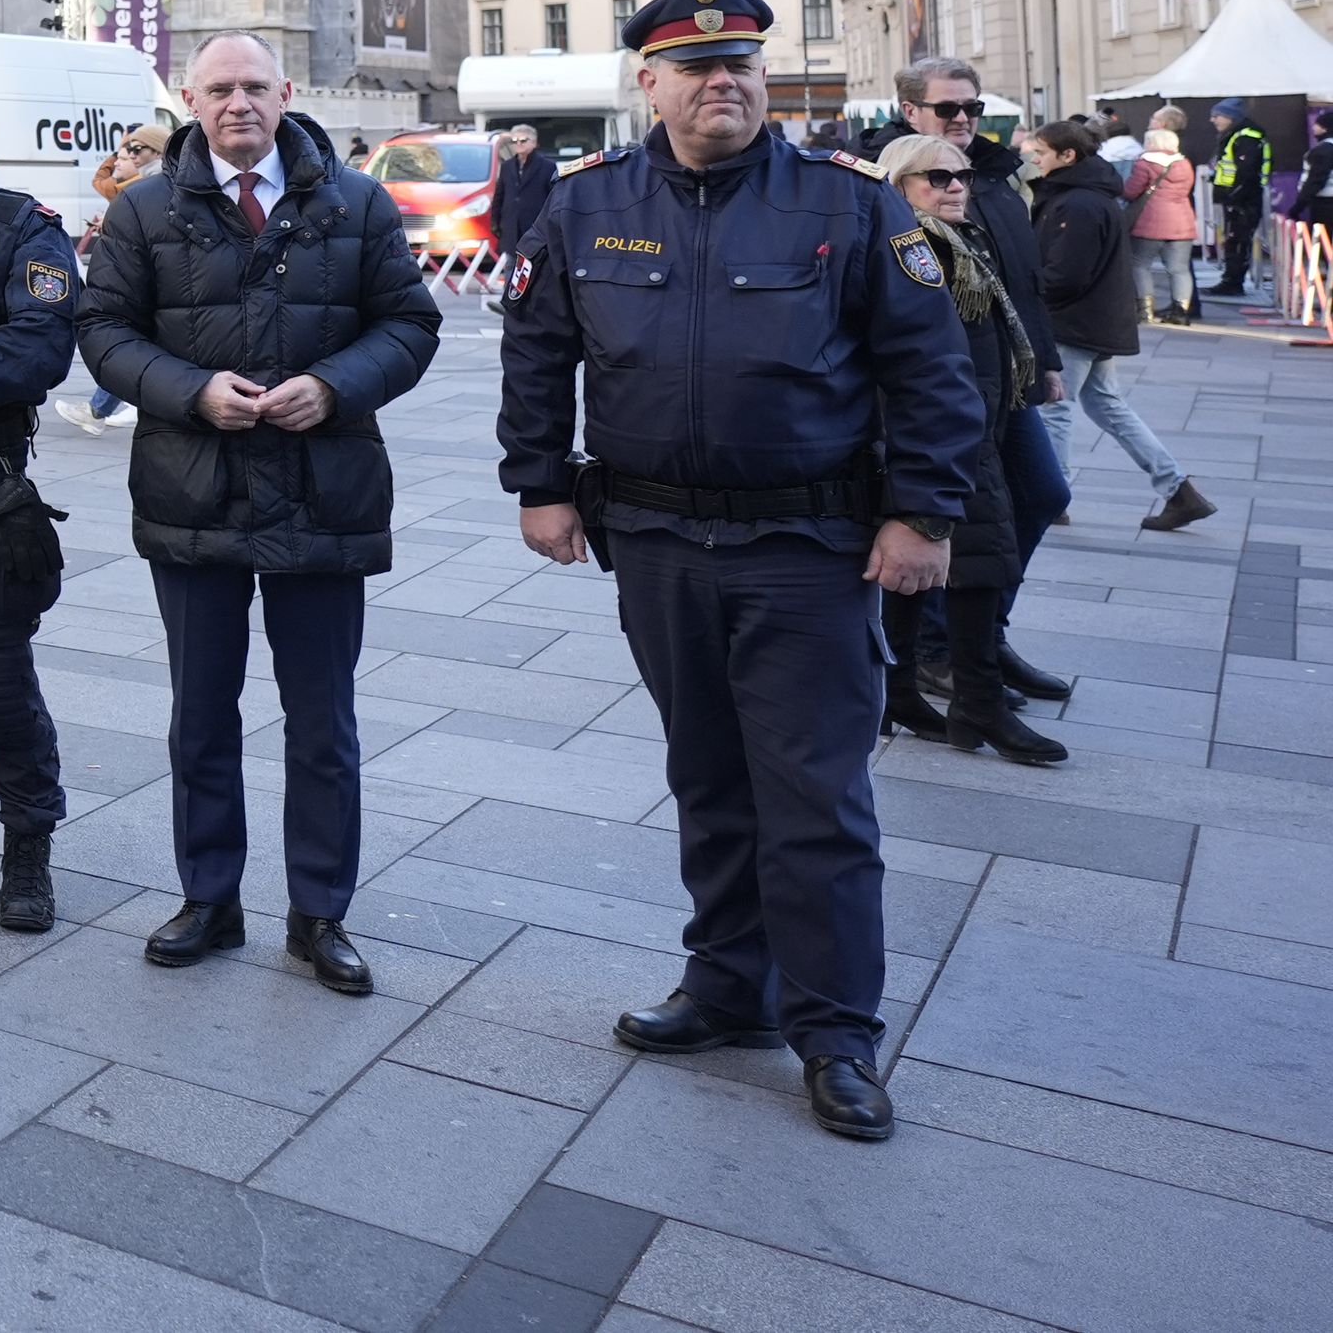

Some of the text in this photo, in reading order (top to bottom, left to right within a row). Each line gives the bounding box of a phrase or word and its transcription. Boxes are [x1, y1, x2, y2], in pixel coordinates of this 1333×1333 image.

[36, 107, 124, 153] redlin
[594, 237, 662, 255] POLIZEI
[894, 231, 924, 249] POLIZEI
[30, 264, 65, 280] POLIZEI
